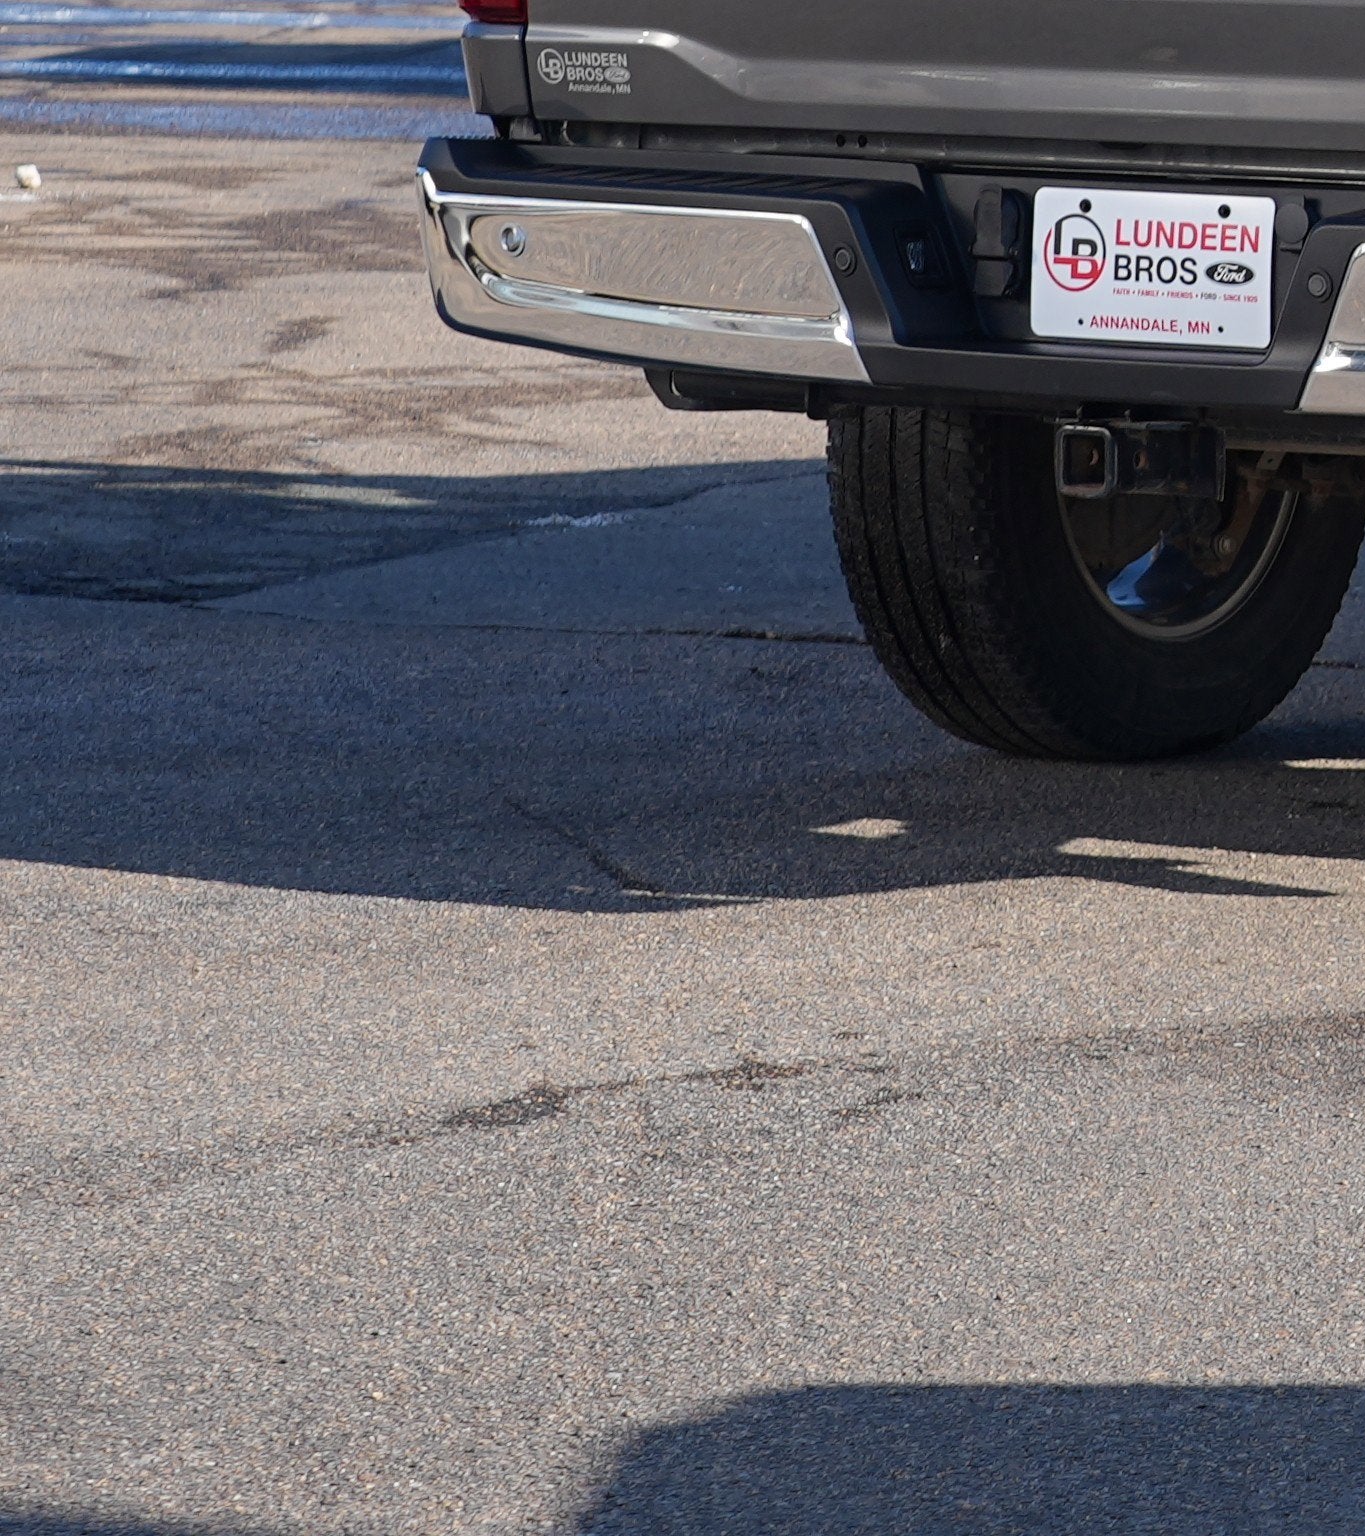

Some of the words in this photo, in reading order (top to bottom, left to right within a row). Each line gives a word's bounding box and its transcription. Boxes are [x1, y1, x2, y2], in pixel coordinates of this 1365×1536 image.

[564, 51, 628, 67] LUNDEEN
[566, 67, 604, 82] BROS
[1115, 219, 1260, 253] LUNDEEN
[1114, 254, 1198, 285] BROS
[1211, 263, 1249, 284] Ford
[1090, 315, 1183, 336] ANNANDALE,
[1188, 321, 1211, 335] MN
